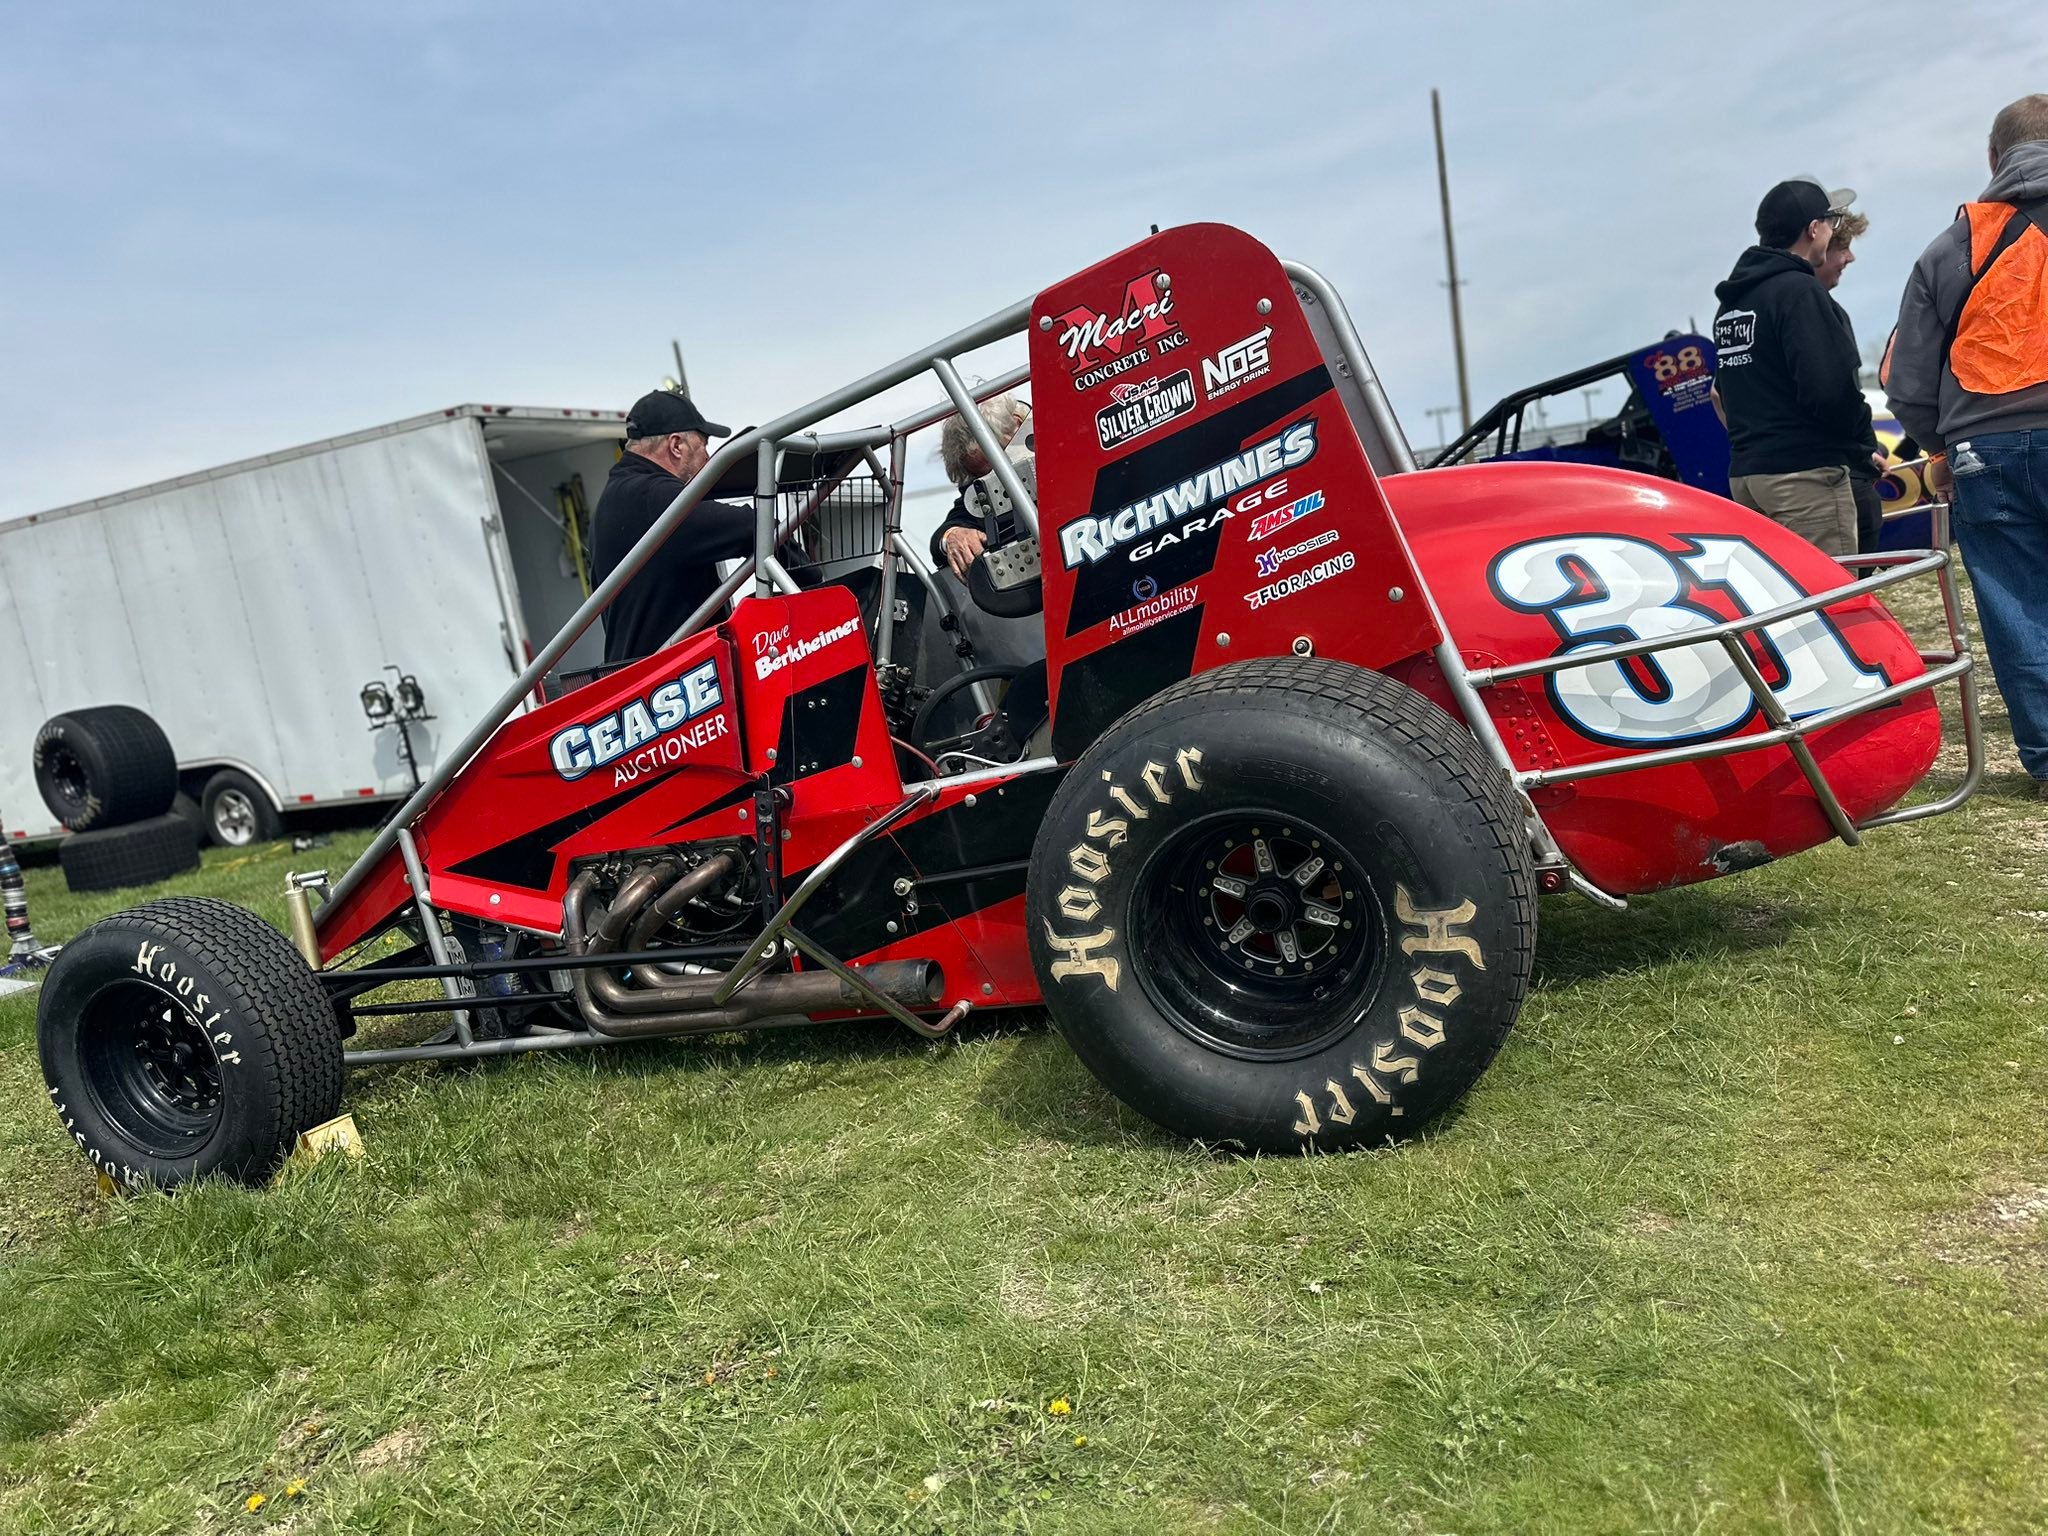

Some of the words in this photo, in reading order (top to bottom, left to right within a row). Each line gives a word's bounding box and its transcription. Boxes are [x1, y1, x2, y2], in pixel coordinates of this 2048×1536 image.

[1059, 289, 1174, 358] Macri
[1074, 347, 1151, 391] CONCRETE
[1156, 331, 1190, 354] INC.
[1122, 376, 1158, 400] USAC
[1201, 325, 1273, 392] NOS
[1207, 379, 1241, 401] ENERGY
[1242, 365, 1271, 384] DRINK
[1653, 346, 1703, 382] 88
[1099, 403, 1145, 442] SILVER
[1143, 379, 1192, 421] CROWN
[1129, 478, 1289, 563] GARAGE
[1249, 491, 1324, 540] AMSOIL
[1277, 531, 1338, 563] HOOSIER
[1109, 585, 1199, 632] ALLmobility
[1258, 552, 1354, 604] FLORACING
[752, 624, 790, 655] Dave
[754, 615, 861, 681] Berkheimer
[1122, 603, 1194, 635] allmobilityservice.com
[1487, 533, 1900, 749] 31
[550, 657, 723, 781] CEASE
[614, 713, 729, 788] AUCTIONEER
[1041, 745, 1206, 993] Hoosier
[130, 939, 242, 1066] Hoosier
[1292, 882, 1488, 1136] Hoosier
